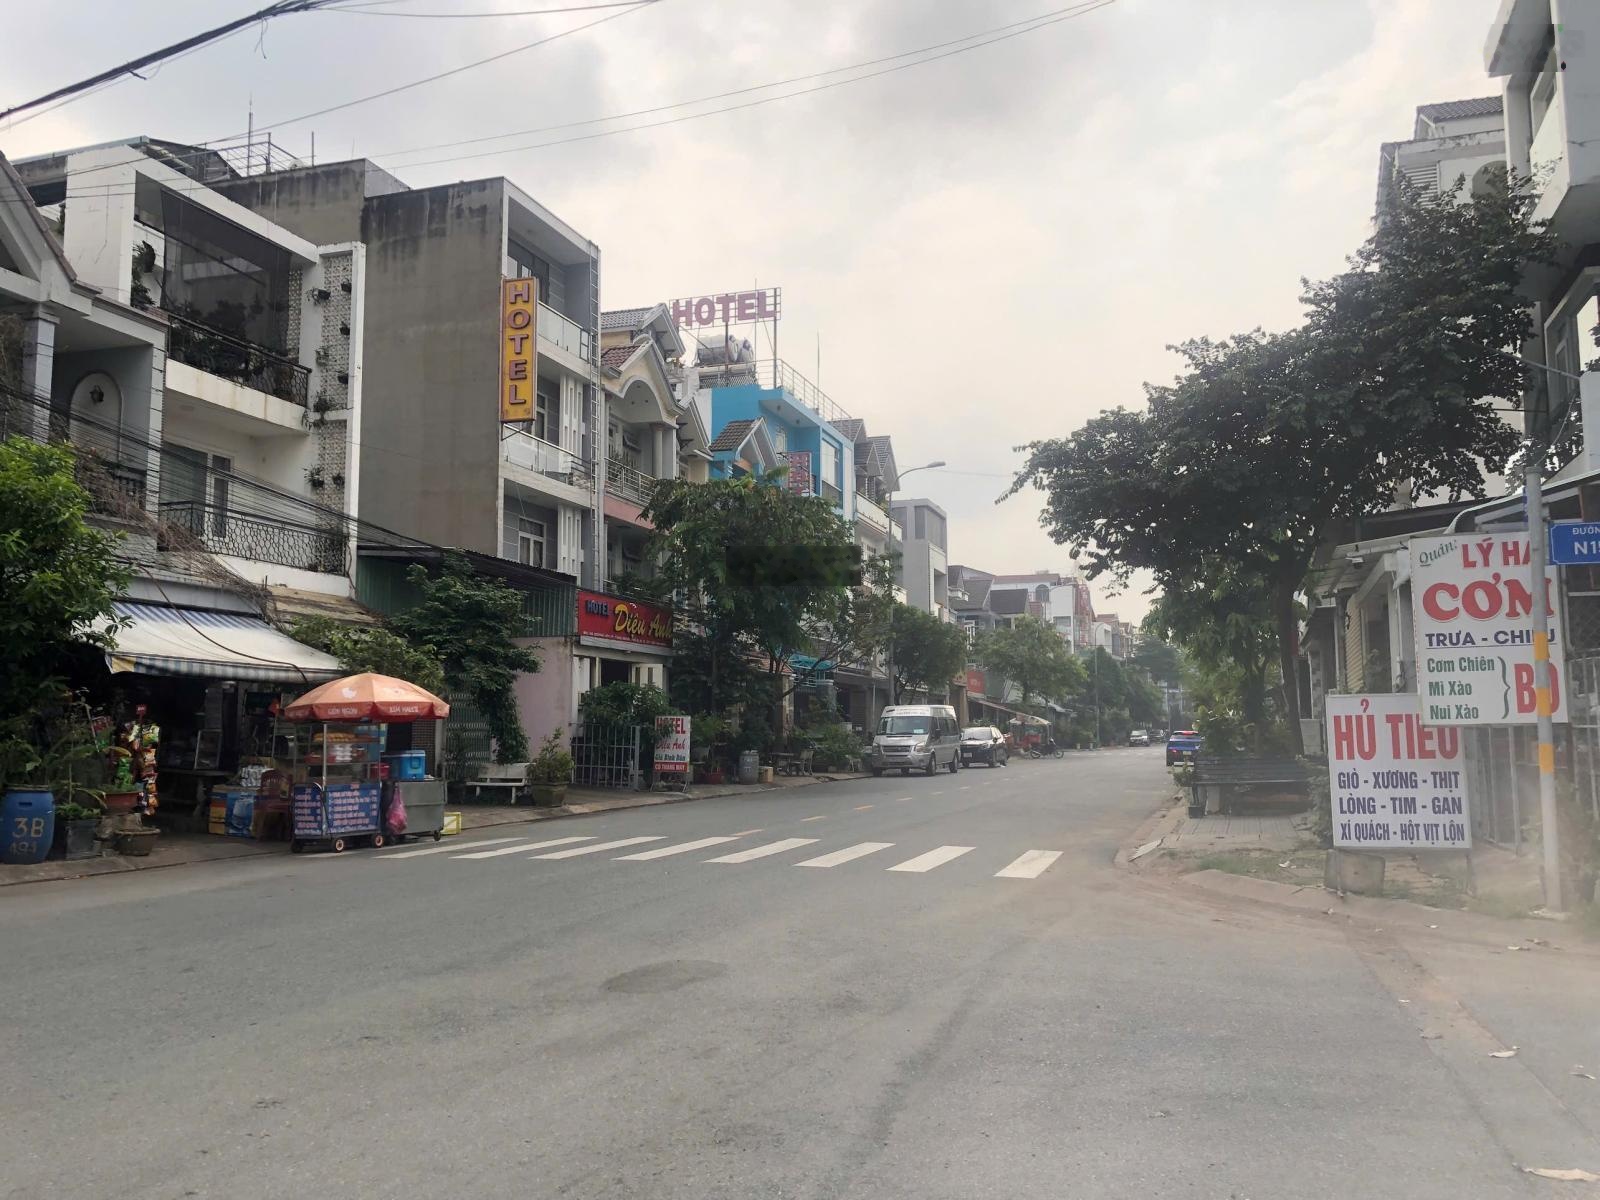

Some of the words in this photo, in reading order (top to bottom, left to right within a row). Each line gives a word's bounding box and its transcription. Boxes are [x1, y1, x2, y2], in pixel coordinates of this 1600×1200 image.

[672, 291, 777, 327] HOTEL
[508, 282, 531, 405] HOTEL
[1461, 537, 1495, 568] LÝ
[1574, 541, 1600, 555] N1
[1422, 572, 1555, 621] CƠM
[1425, 630, 1476, 647] TRƯA
[1493, 628, 1556, 645] CHIU
[1427, 657, 1455, 673] Cơm
[1458, 656, 1495, 672] Chiên
[1428, 681, 1445, 697] Mì
[1449, 680, 1473, 696] Xào
[1429, 704, 1451, 720] Nui
[1455, 704, 1479, 719] Xào
[1333, 698, 1377, 761] HỦ
[1337, 768, 1360, 790] GIÒ
[1372, 769, 1418, 790] XƯƠNG
[1431, 771, 1460, 793] THỊT
[1339, 793, 1377, 815] LÒNG
[1390, 797, 1417, 815] TIM
[1431, 797, 1463, 815] GAN
[1354, 820, 1390, 843] QUÁCH
[1400, 820, 1421, 845] HỘT
[1423, 823, 1440, 845] VỊT
[1443, 820, 1465, 845] LỘN
